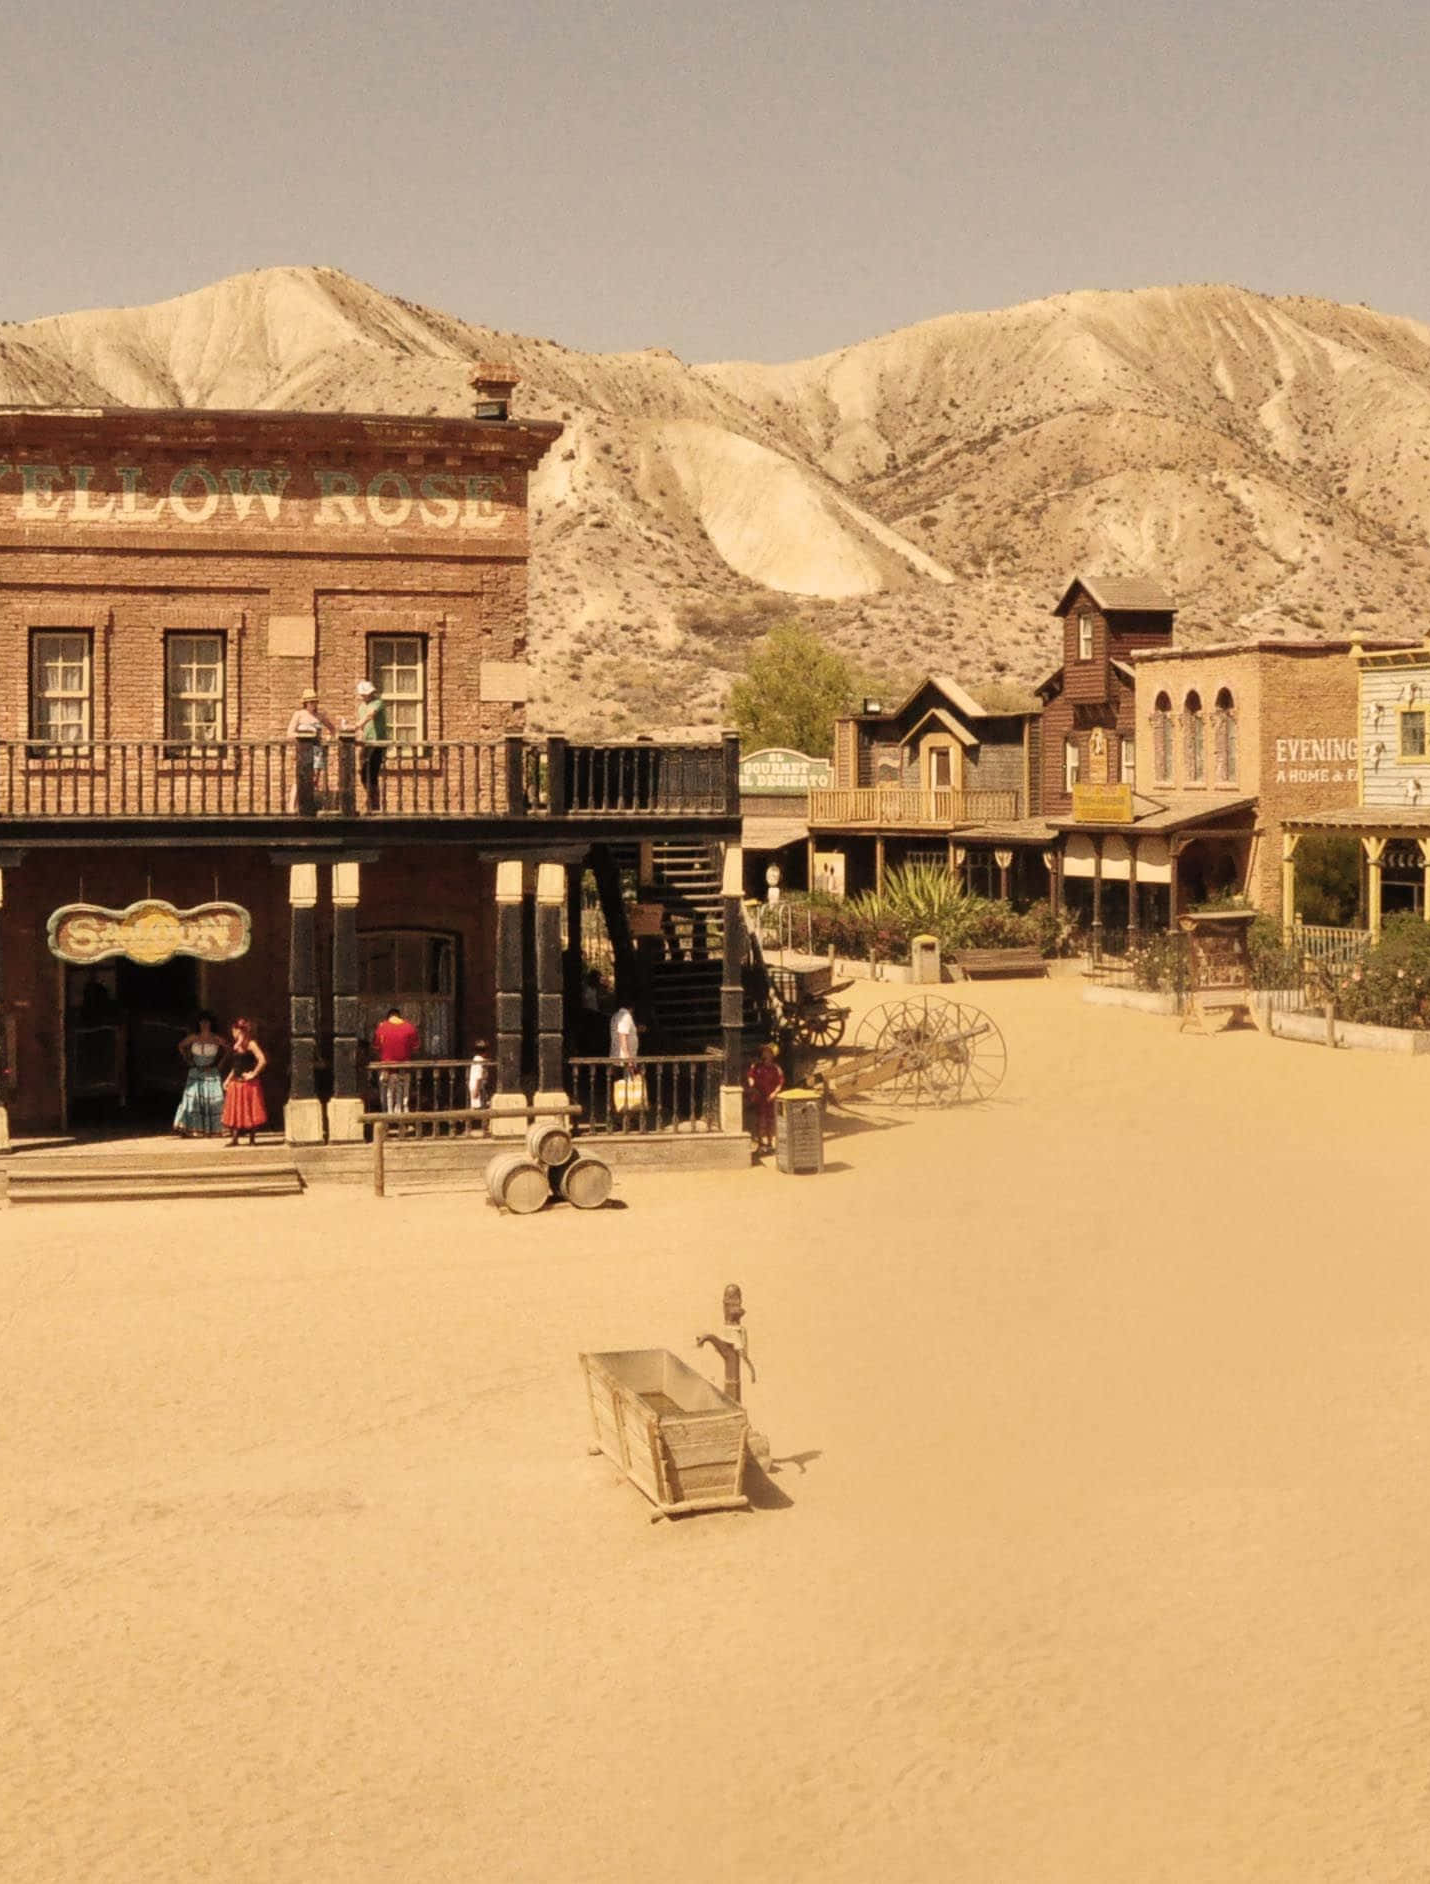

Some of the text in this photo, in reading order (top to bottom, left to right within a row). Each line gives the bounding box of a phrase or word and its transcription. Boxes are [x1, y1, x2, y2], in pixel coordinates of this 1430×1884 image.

[313, 470, 507, 528] ROSE
[1276, 738, 1358, 761] EVENING
[769, 753, 784, 762] EL
[743, 762, 810, 774] GOURMET
[757, 774, 828, 787] DESIERTO
[1276, 770, 1286, 784] A
[1289, 769, 1330, 783] HOME
